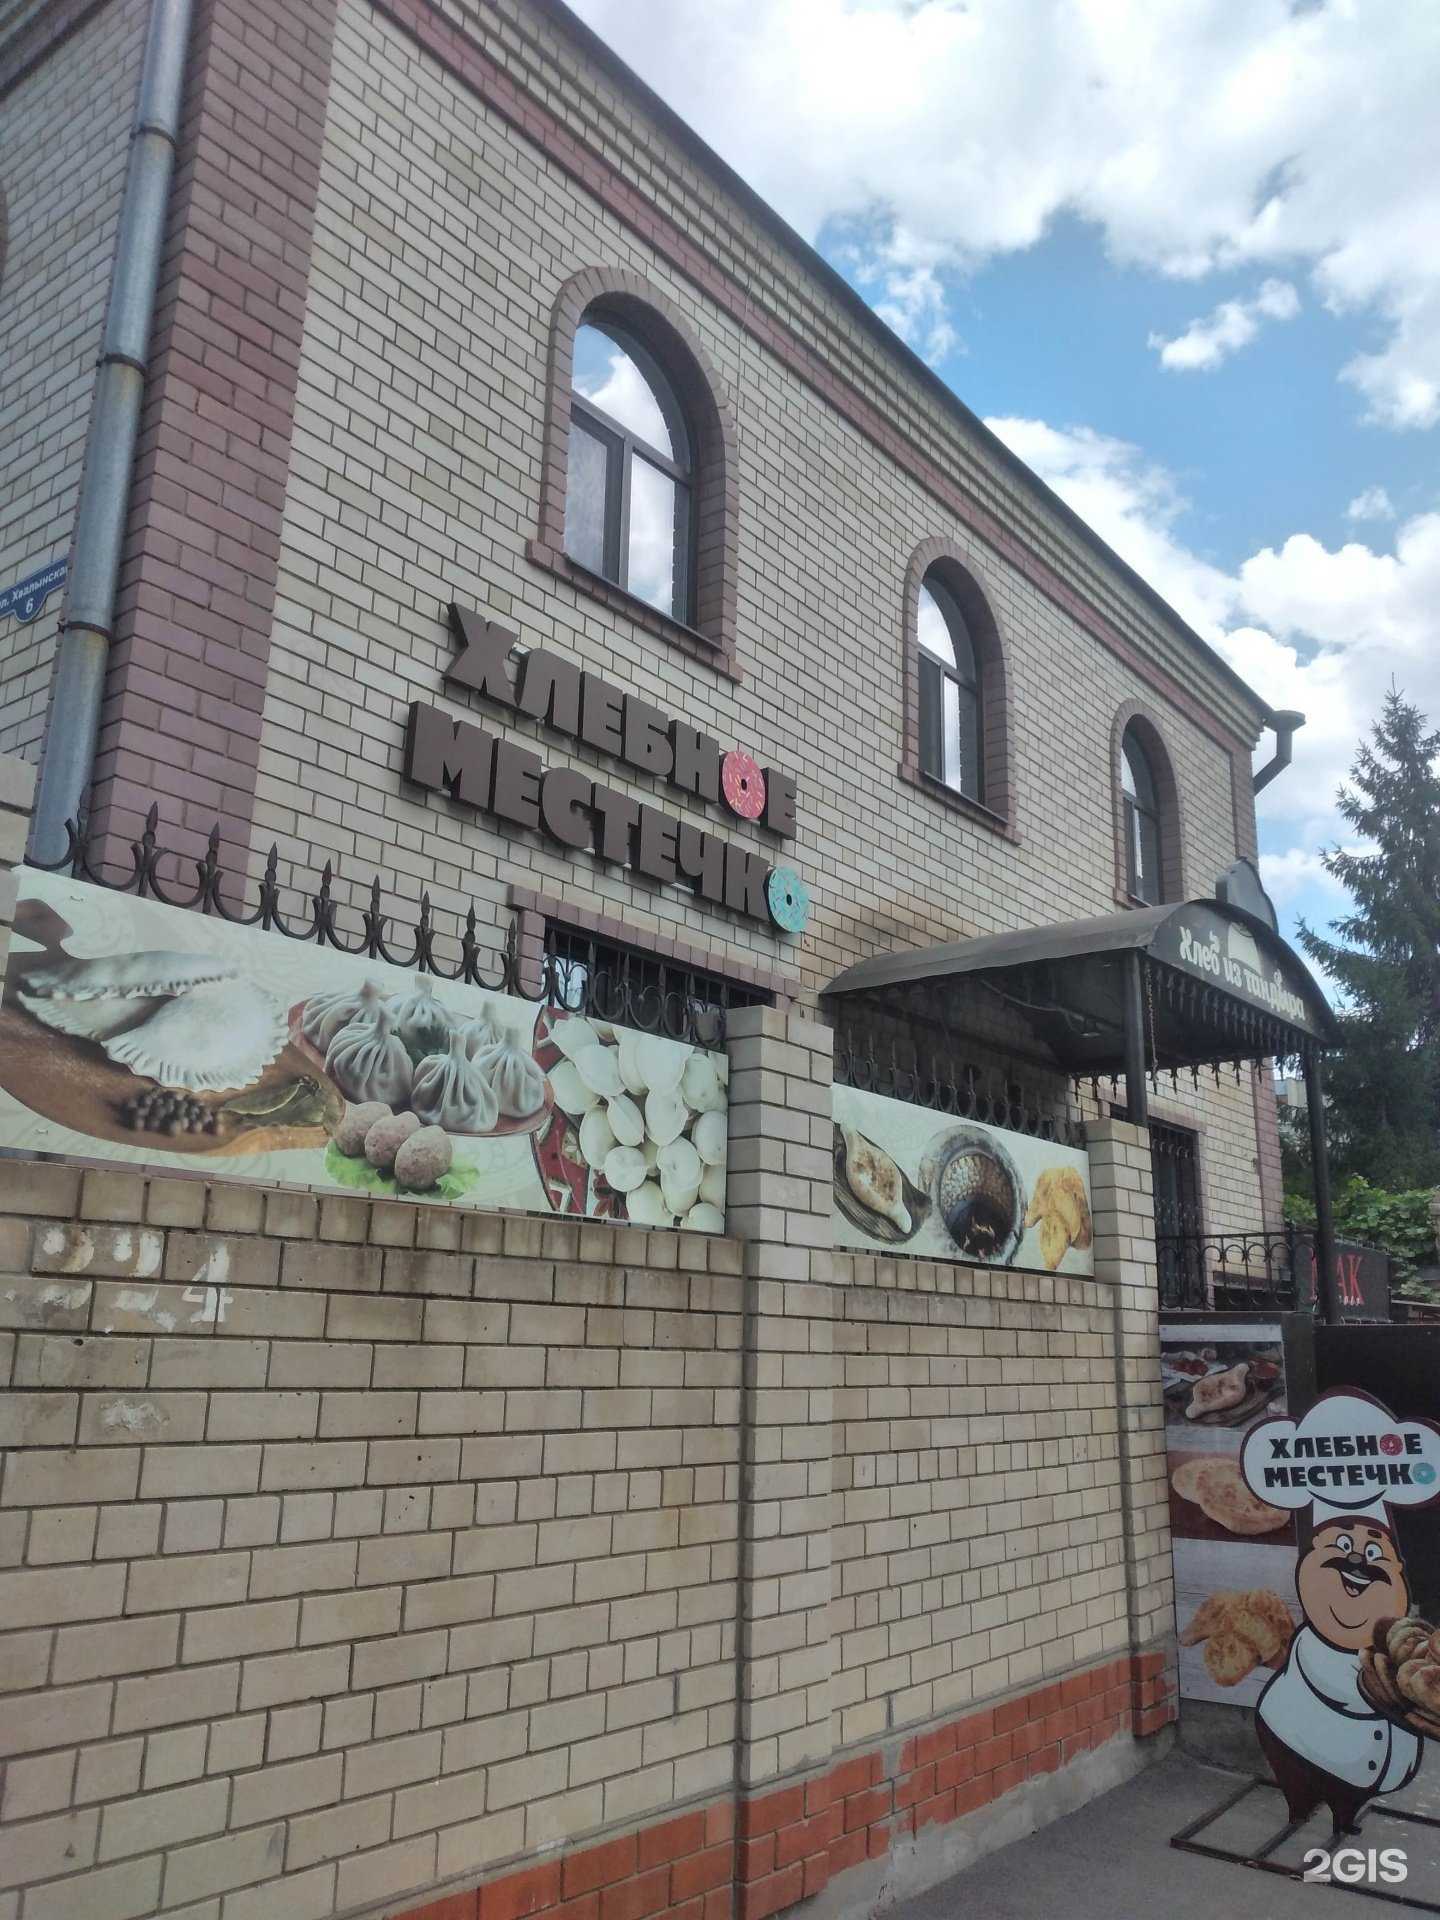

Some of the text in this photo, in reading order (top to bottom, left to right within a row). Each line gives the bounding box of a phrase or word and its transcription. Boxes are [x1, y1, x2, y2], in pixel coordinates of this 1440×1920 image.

[26, 598, 34, 614] 6
[442, 602, 798, 840] ХЛЕБНОЕ
[404, 700, 809, 934] МЕСТЕЧКО
[1179, 925, 1220, 976] Хлеб
[1222, 956, 1242, 988] из
[1269, 1433, 1423, 1459] ХЛЕБНОЕ
[1263, 1462, 1436, 1488] МЕСТЕЧКО
